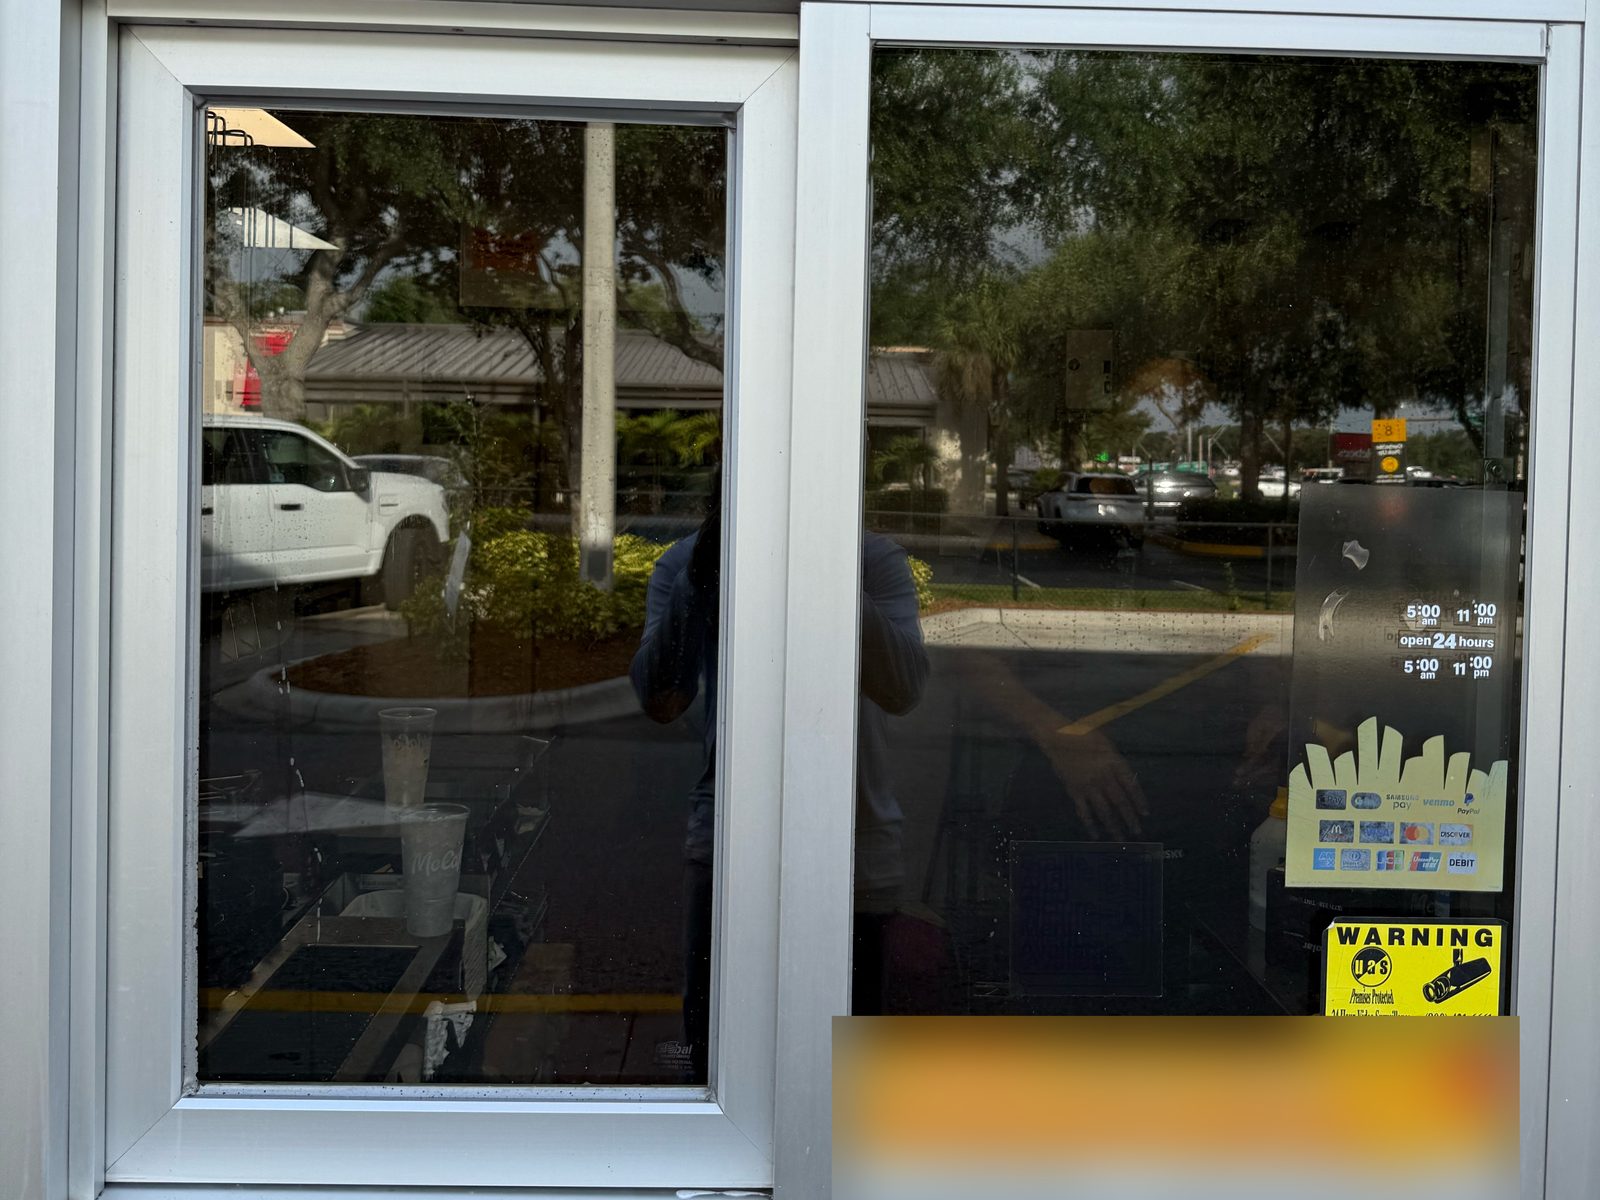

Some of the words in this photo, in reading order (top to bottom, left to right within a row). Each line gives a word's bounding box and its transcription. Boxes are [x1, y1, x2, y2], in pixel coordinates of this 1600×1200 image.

[1407, 604, 1441, 618] 5:00
[1477, 616, 1493, 626] pm
[1400, 636, 1431, 648] open
[1433, 632, 1457, 649] 24
[1459, 636, 1495, 648] hours
[1420, 671, 1436, 679] am
[1473, 669, 1490, 679] pm
[1392, 801, 1412, 810] pay
[1423, 799, 1455, 807] venmo
[1456, 807, 1481, 815] PayPal
[1449, 858, 1475, 867] DEBIT
[1336, 926, 1493, 948] WARNING
[1349, 987, 1371, 1004] Premises
